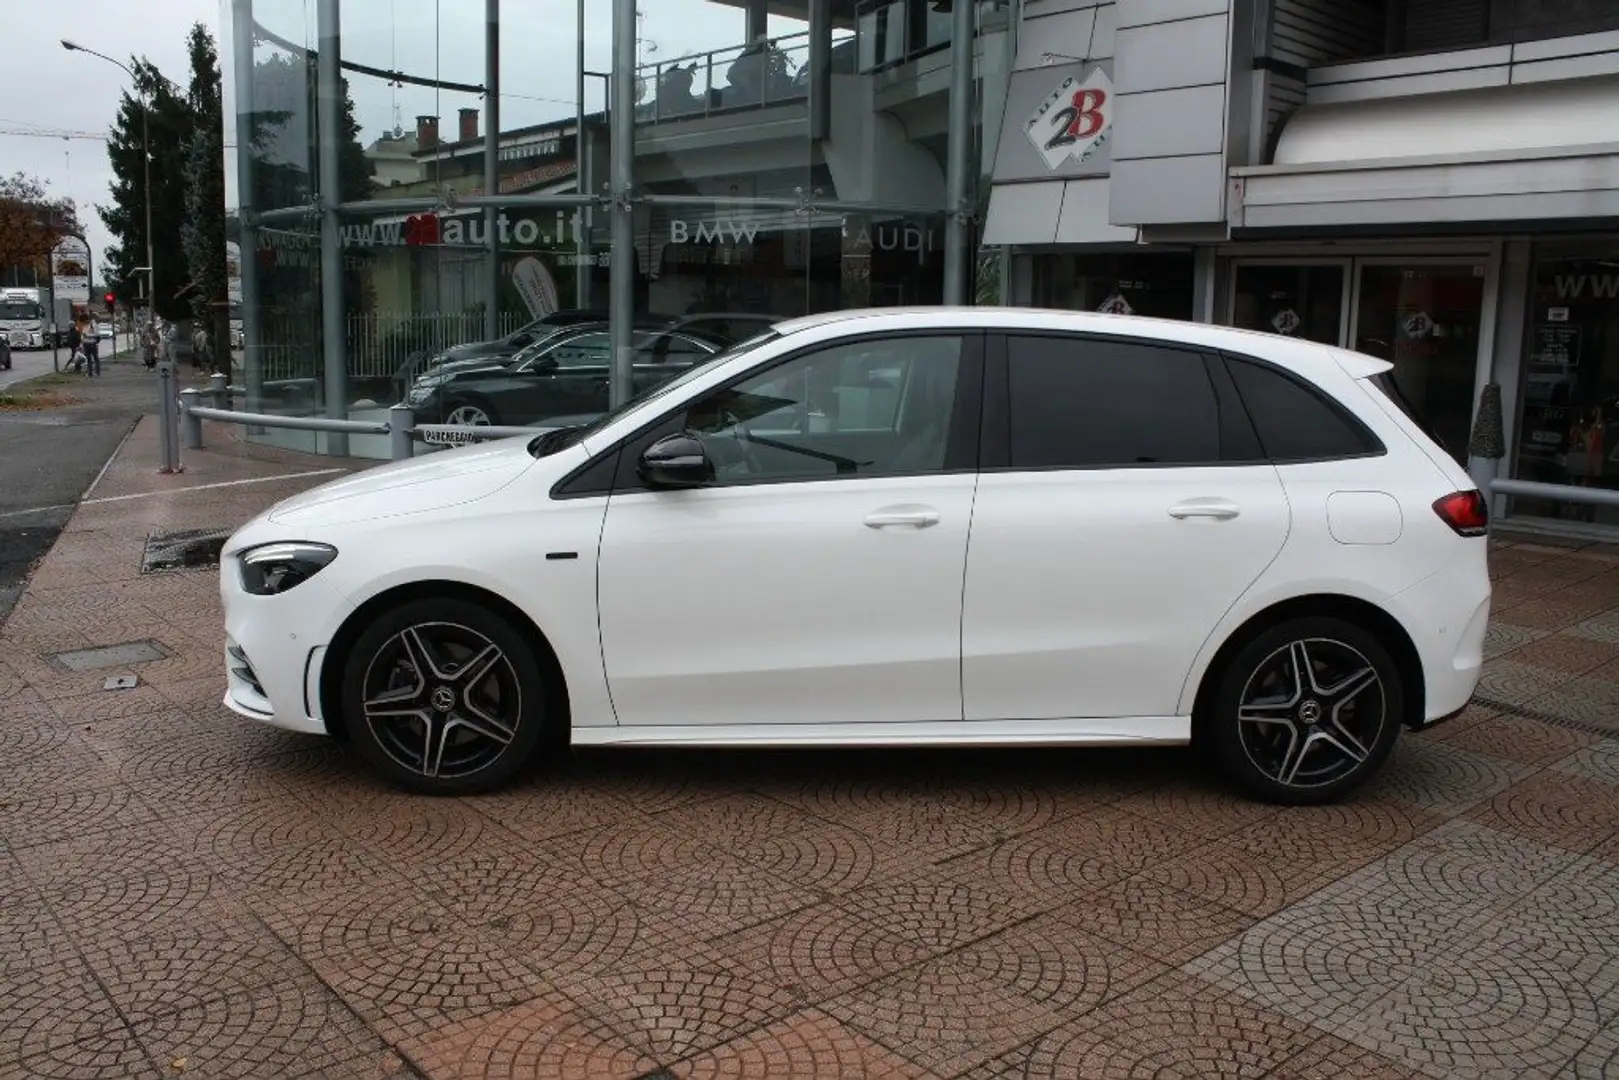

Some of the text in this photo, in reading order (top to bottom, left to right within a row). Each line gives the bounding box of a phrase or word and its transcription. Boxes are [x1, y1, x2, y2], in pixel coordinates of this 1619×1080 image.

[1043, 87, 1106, 151] 2B
[669, 218, 760, 245] BMW
[854, 225, 934, 252] AUDI
